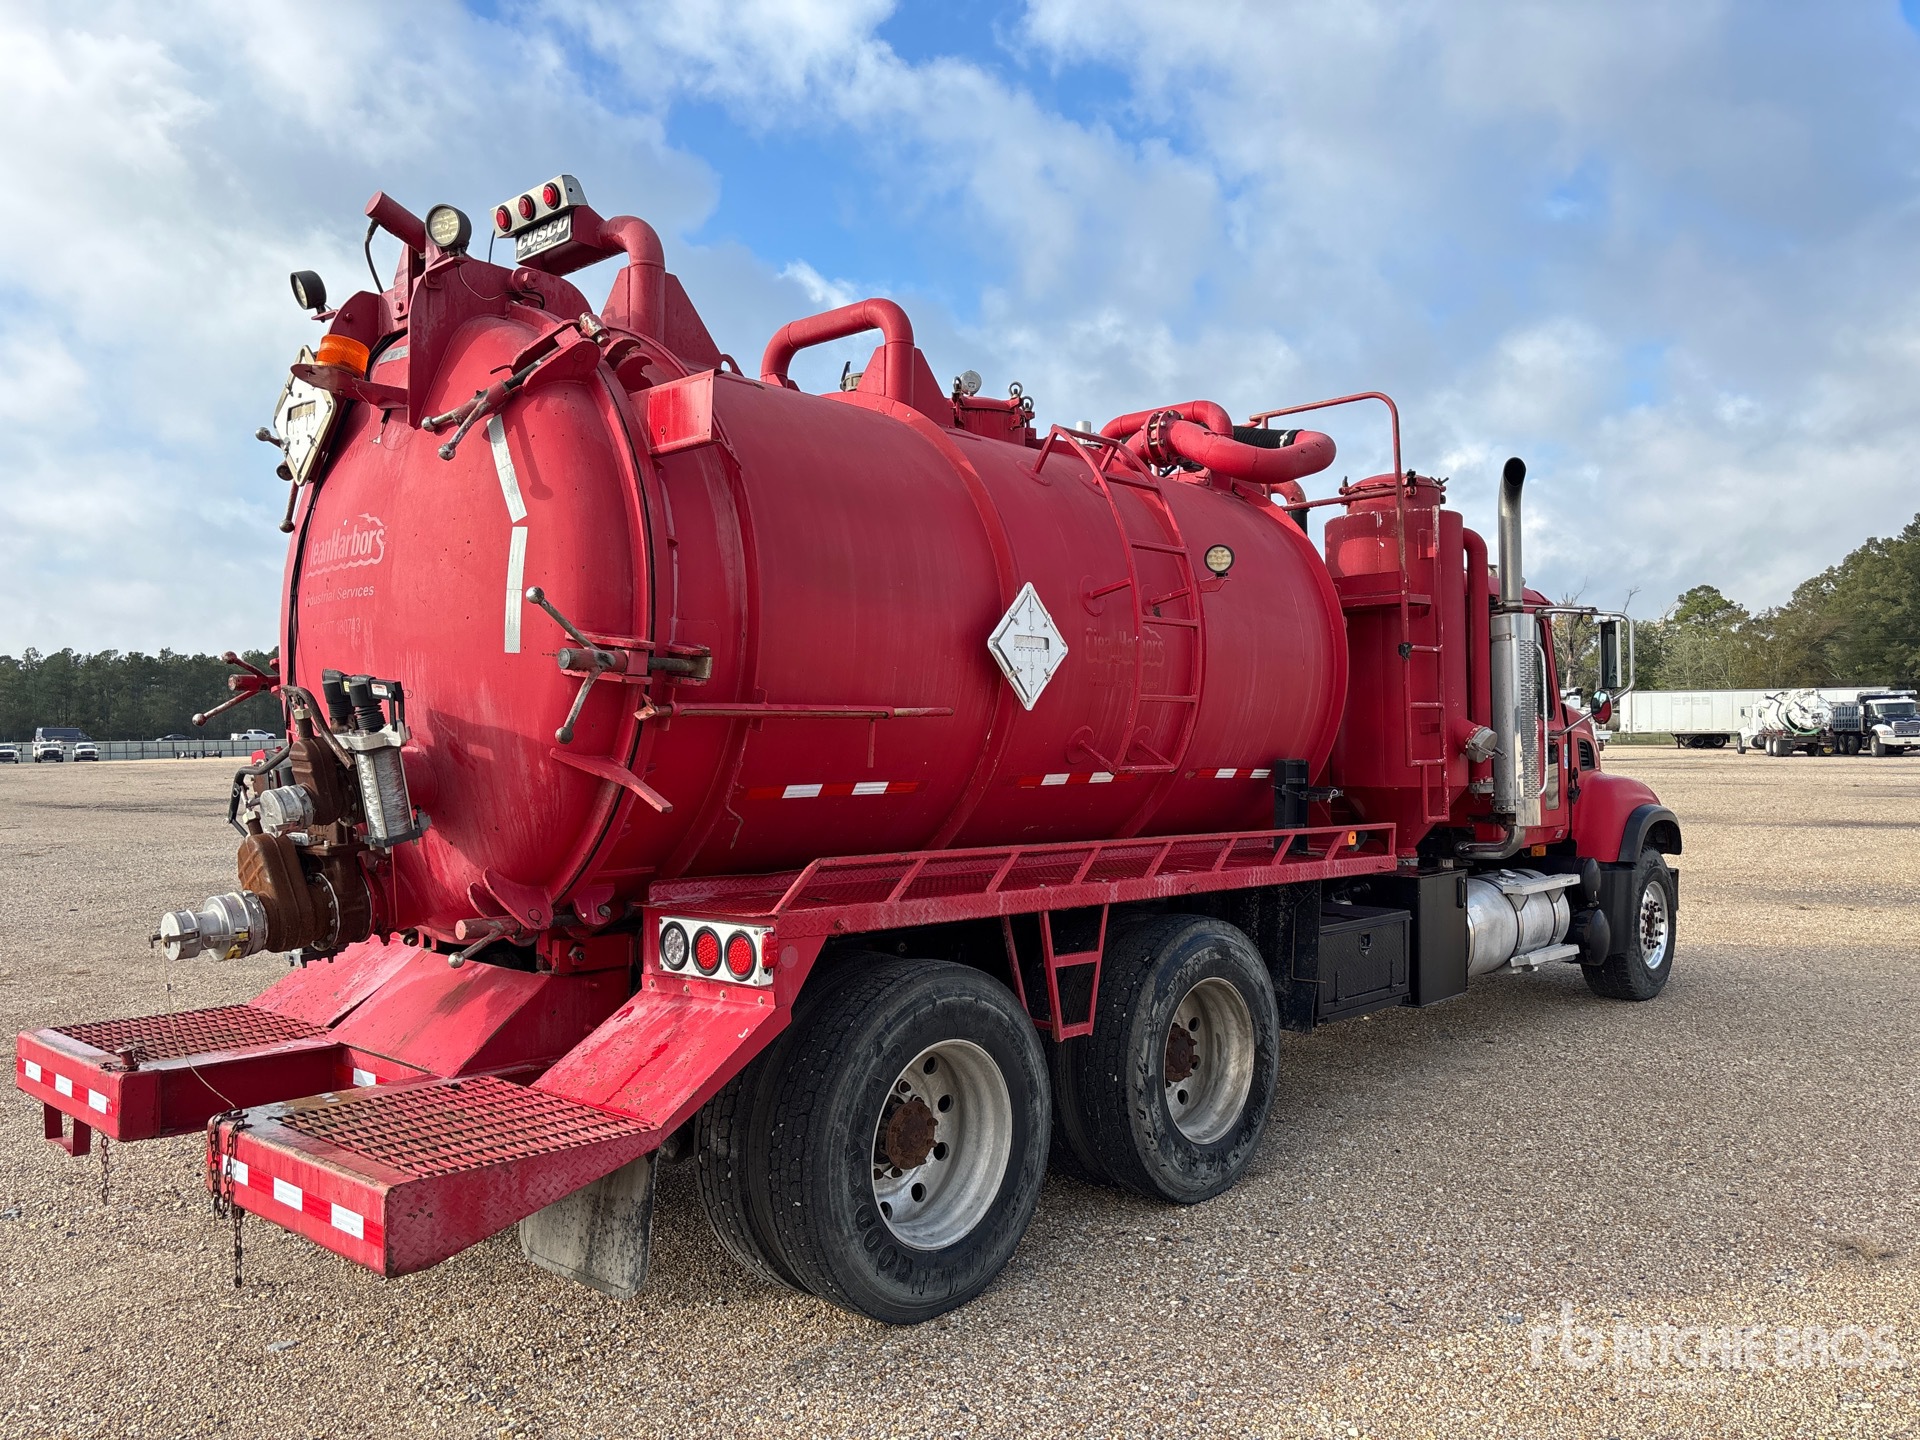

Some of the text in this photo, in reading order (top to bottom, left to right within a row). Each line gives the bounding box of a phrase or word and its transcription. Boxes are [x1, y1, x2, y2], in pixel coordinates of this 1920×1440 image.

[517, 215, 569, 251] CUSCO
[308, 523, 386, 568] leanHarbors
[336, 585, 375, 601] Services
[1672, 696, 1711, 706] EPES
